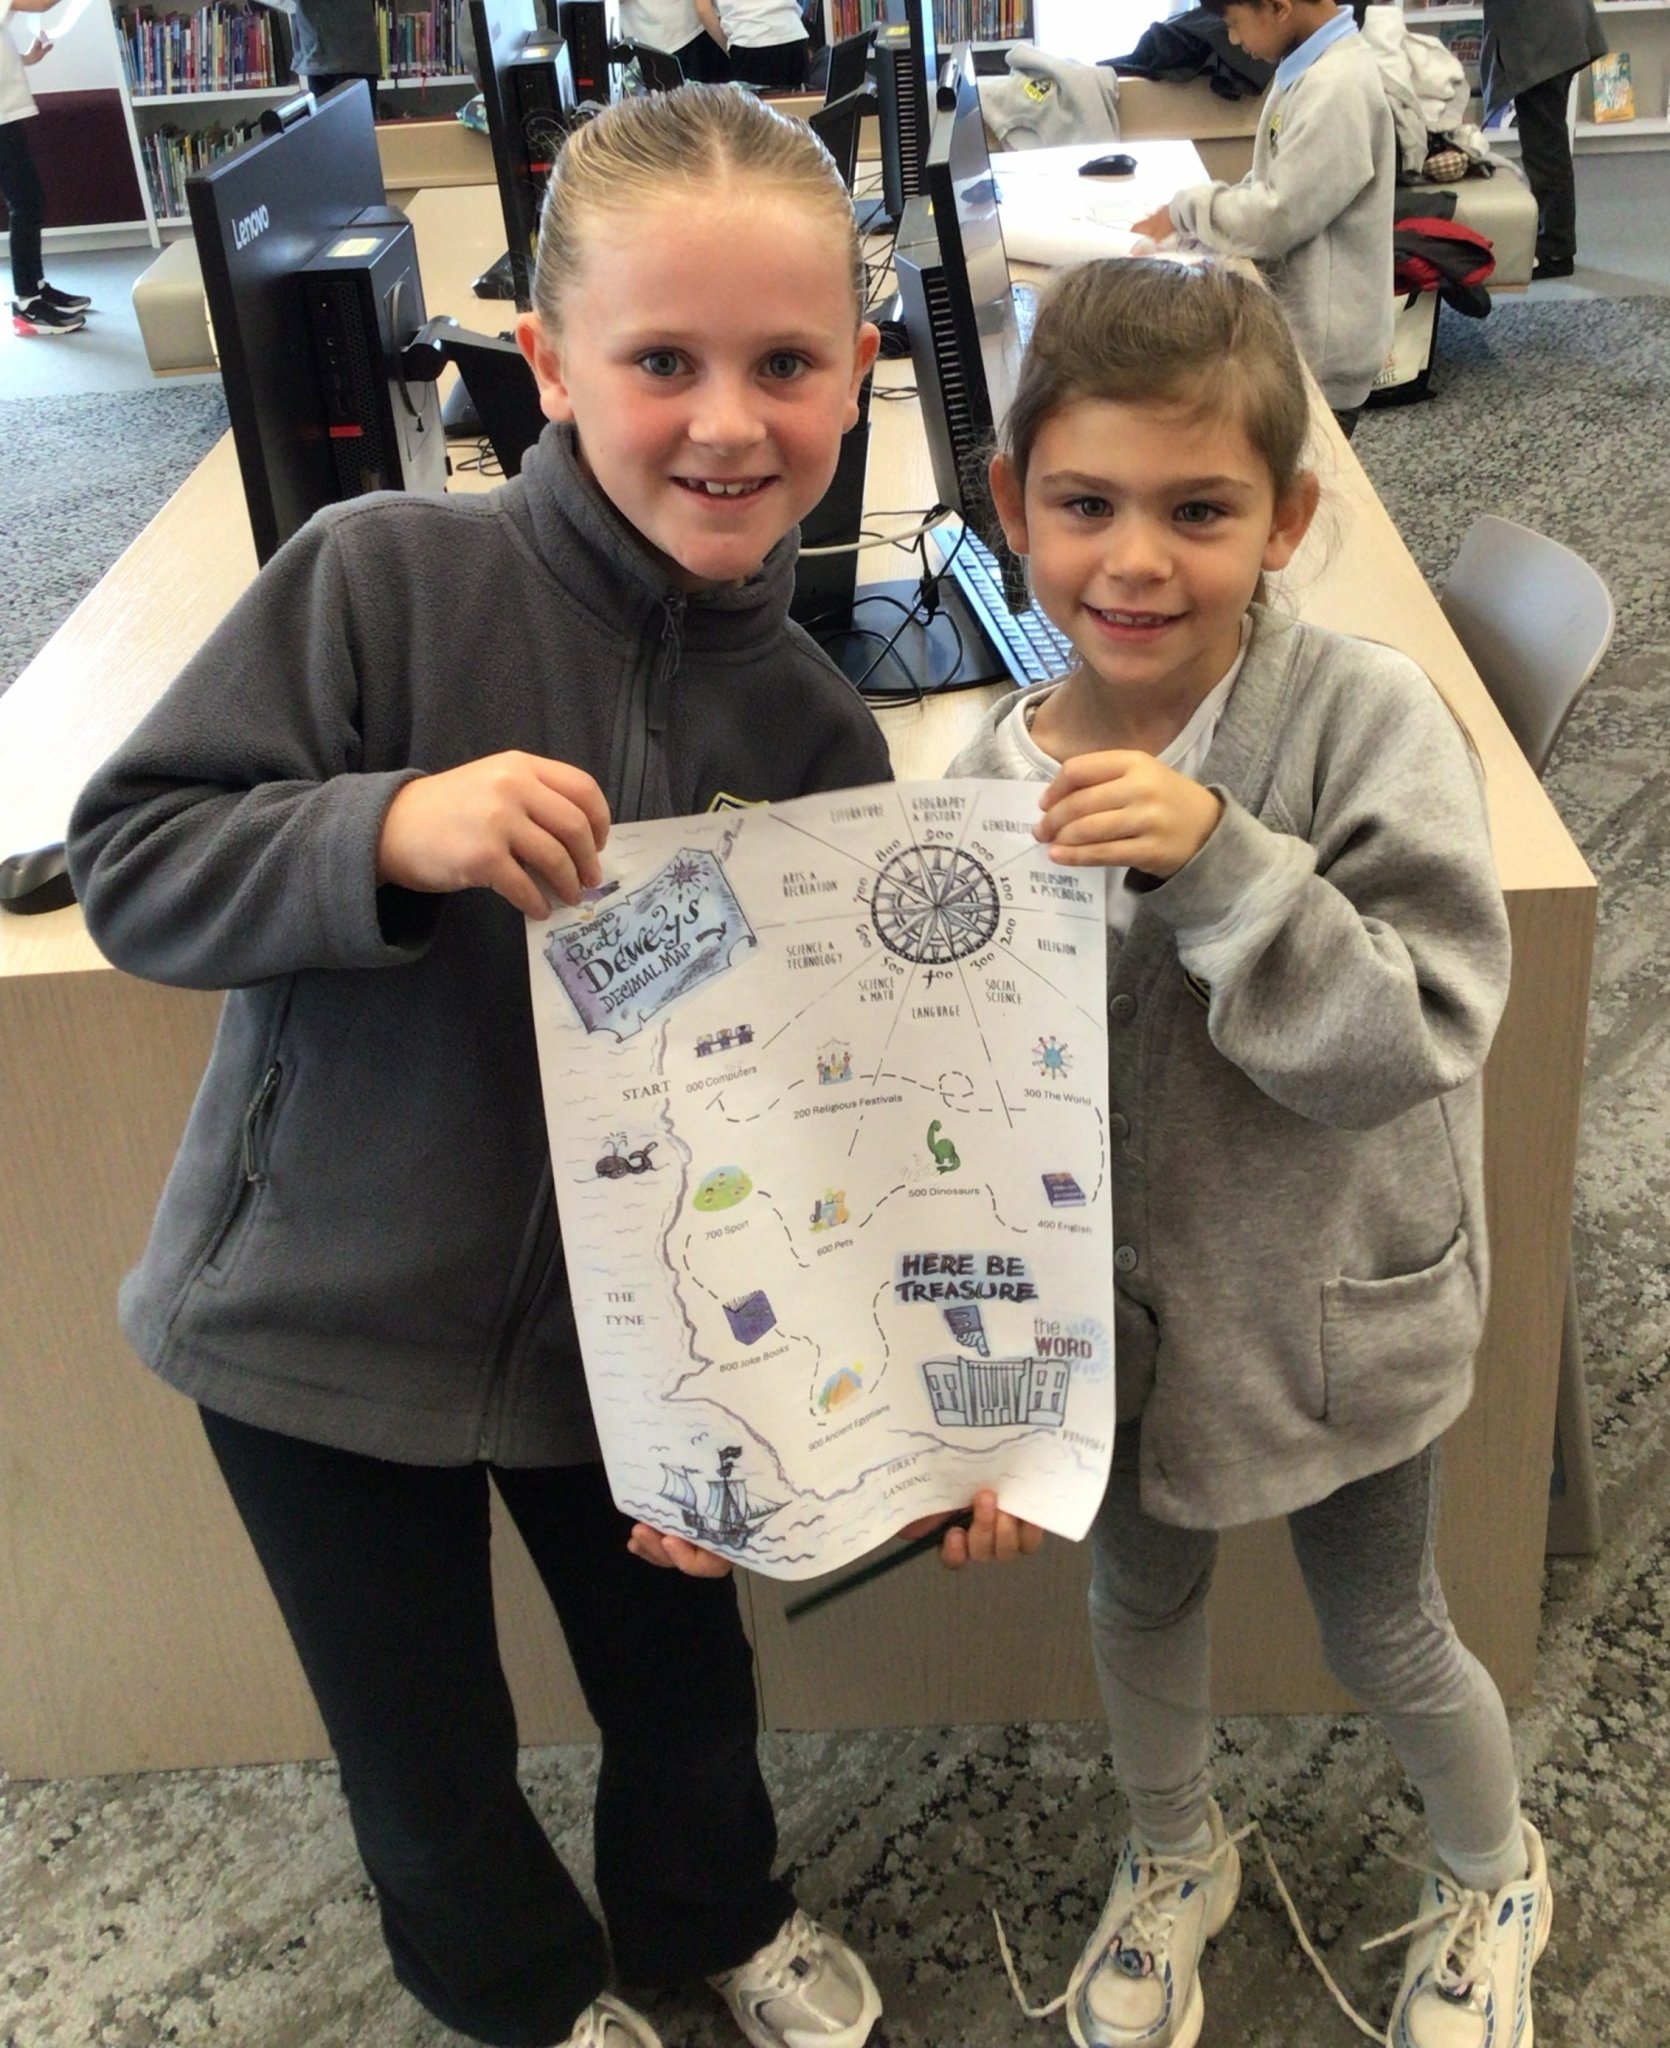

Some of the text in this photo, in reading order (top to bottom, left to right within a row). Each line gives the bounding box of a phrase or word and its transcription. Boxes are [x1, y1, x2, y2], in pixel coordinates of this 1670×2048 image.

[231, 203, 270, 250] Lenovo
[912, 795, 966, 810] GEOGRAPHY
[924, 810, 962, 823] HISTORY
[924, 829, 954, 843] 900
[875, 839, 901, 863] 800
[971, 841, 994, 862] 000
[782, 871, 805, 886] ARTS
[783, 880, 839, 898] RECREATION
[853, 877, 873, 905] 700
[999, 876, 1014, 902] 100
[1041, 884, 1094, 904] PSYCHOLOGY
[579, 912, 616, 937] DREAD
[1000, 918, 1017, 946] 200
[856, 923, 873, 949] 600
[786, 941, 823, 957] SCIENCE
[1037, 938, 1077, 956] RELIGION
[787, 952, 843, 970] TECHNOLOGY
[881, 956, 905, 976] 500
[969, 952, 996, 971] 300
[599, 942, 693, 1014] DECIMAL MAP
[858, 976, 895, 992] SCIENCE
[922, 969, 954, 990] 400
[985, 979, 1017, 993] SOCIAL
[870, 990, 895, 1003] MATH
[985, 991, 1022, 1005] SCIENCE
[912, 1004, 960, 1019] LANGUAGE
[686, 1080, 704, 1093] 000
[705, 1065, 758, 1088] Computers
[622, 1080, 671, 1102] START
[1023, 1088, 1092, 1106] 300 The World
[793, 1094, 903, 1120] 200 Religious Festivals
[908, 1186, 980, 1198] 500 Dinosaurs
[704, 1220, 750, 1241] 700 Sport
[1037, 1219, 1093, 1235] 400 English
[816, 1238, 854, 1257] 600 Pets
[902, 1253, 1026, 1277] HERE BE
[604, 1291, 635, 1303] THE
[895, 1280, 1039, 1303] TREASURE
[603, 1314, 645, 1326] TYNE
[1034, 1316, 1061, 1336] the
[1035, 1337, 1092, 1359] WORD
[719, 1344, 790, 1373] 800 Joke Books
[808, 1438, 824, 1453] 900
[825, 1422, 853, 1443] Ancient
[882, 1471, 931, 1500] LANDING
